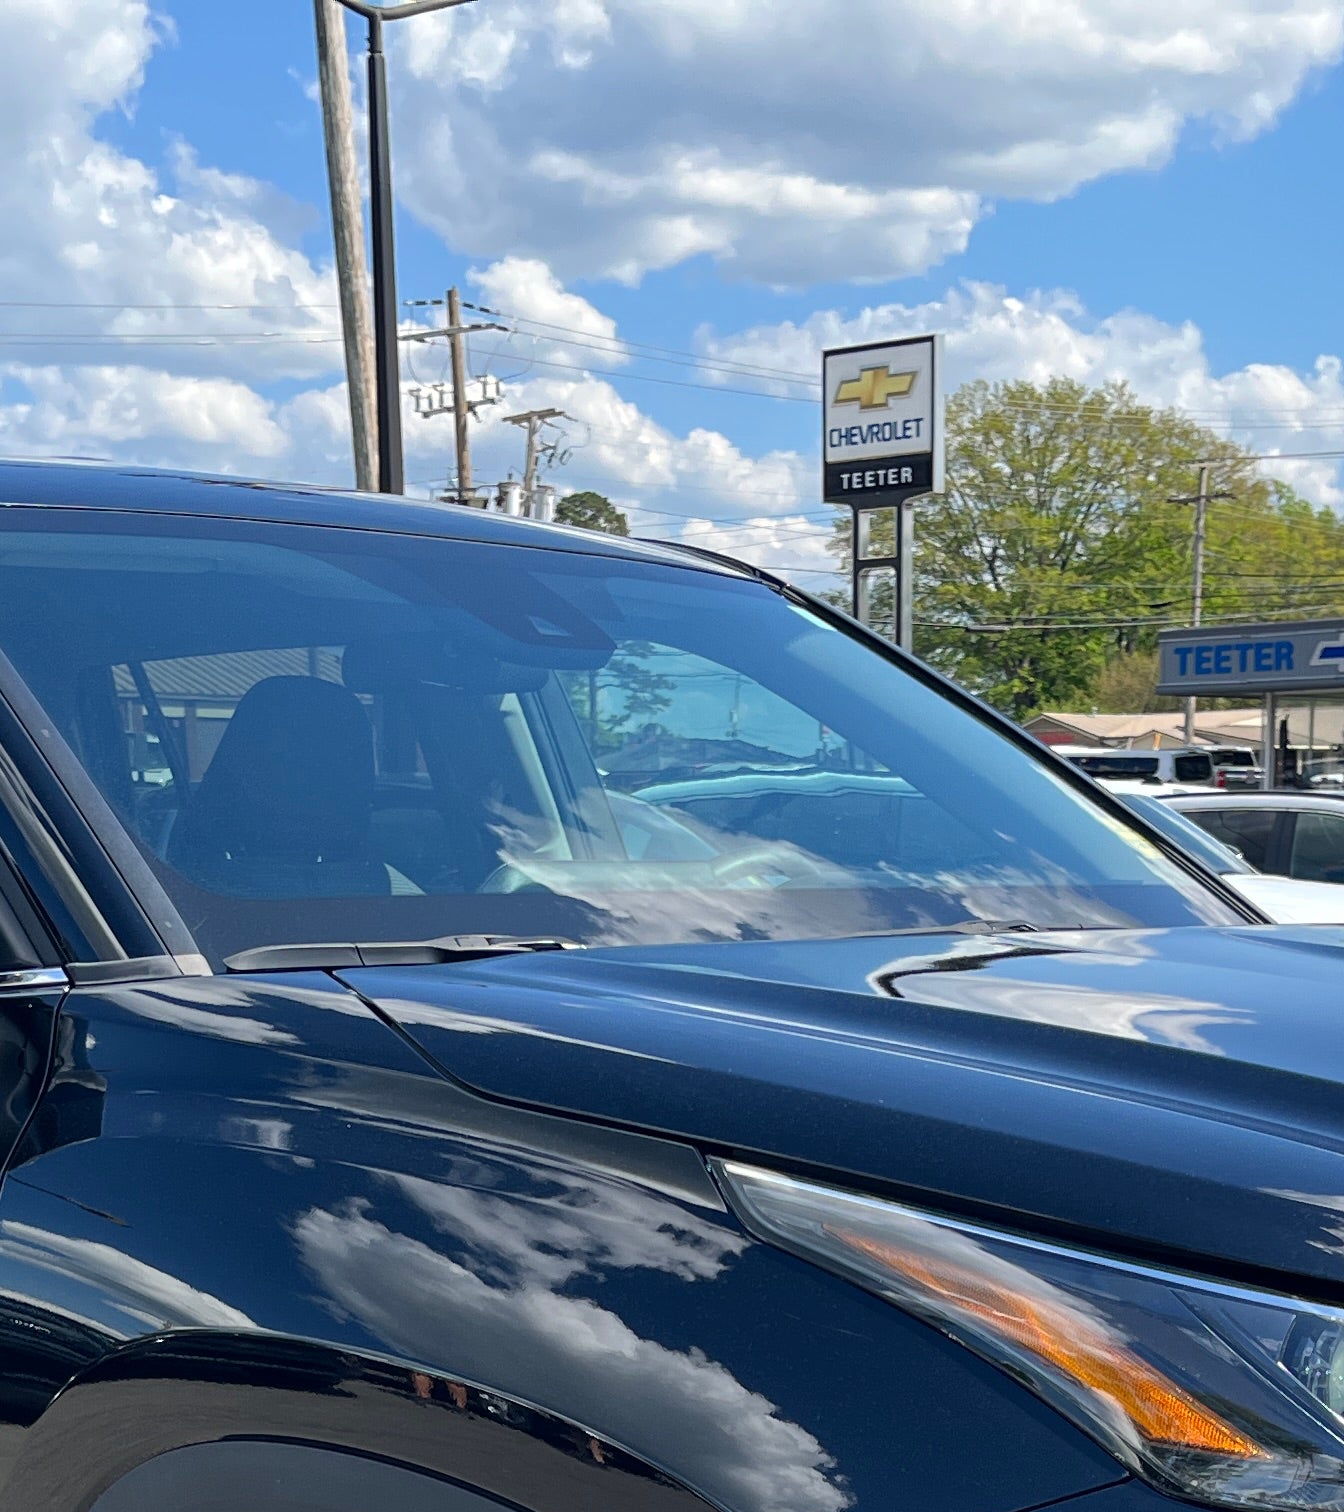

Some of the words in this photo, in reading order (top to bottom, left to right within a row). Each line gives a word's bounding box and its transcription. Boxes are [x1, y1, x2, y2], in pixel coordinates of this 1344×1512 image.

[830, 418, 923, 448] CHEVROLET
[841, 467, 912, 489] TEETER
[1174, 641, 1293, 675] TEETER
